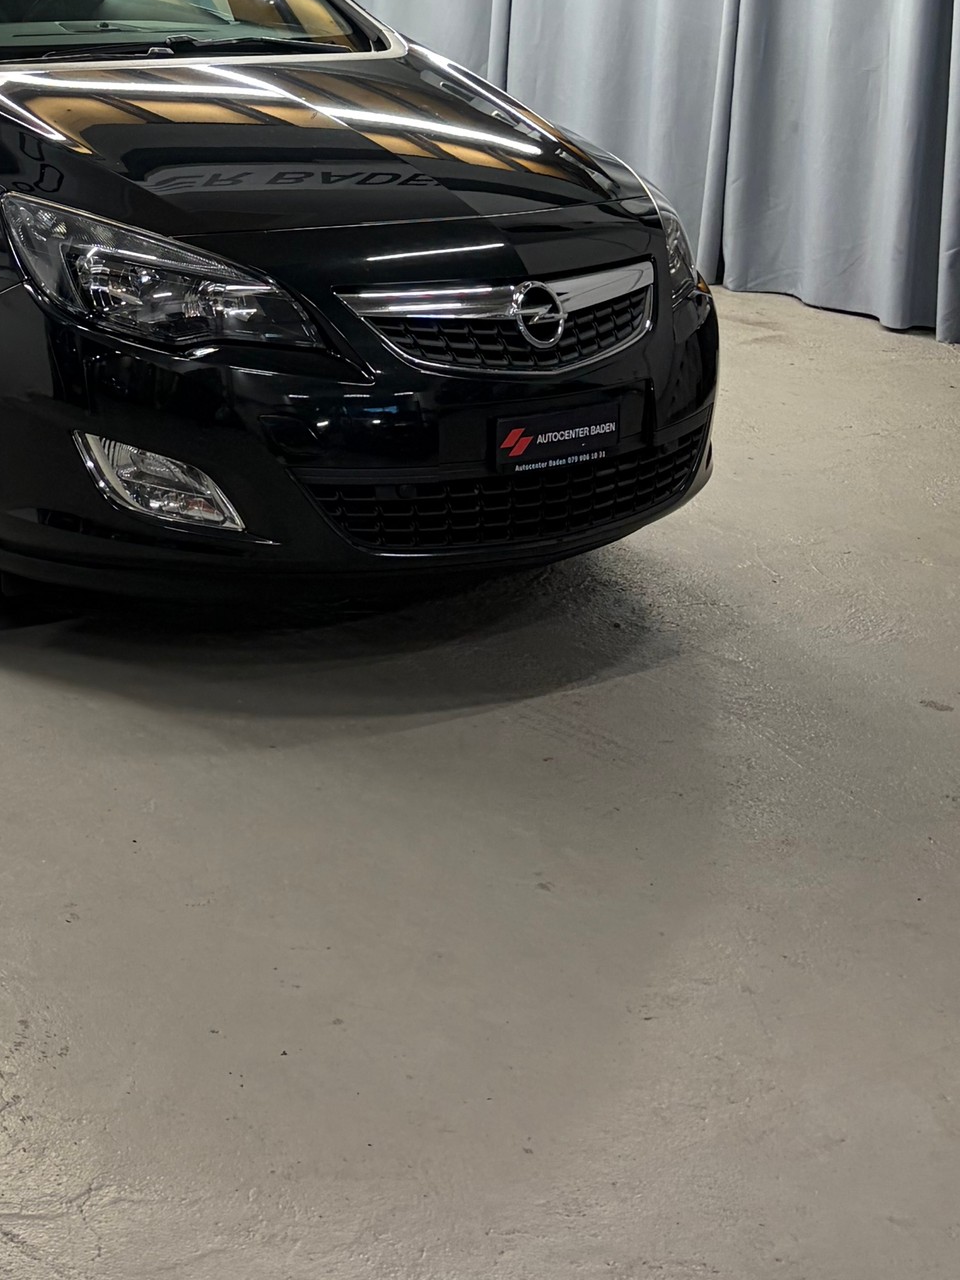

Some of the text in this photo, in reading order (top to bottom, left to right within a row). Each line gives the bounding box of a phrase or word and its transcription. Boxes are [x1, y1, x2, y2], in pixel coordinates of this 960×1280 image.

[537, 422, 616, 444] AUTOCENTER BADEN
[515, 461, 548, 472] Autocenter
[549, 459, 567, 467] Baden
